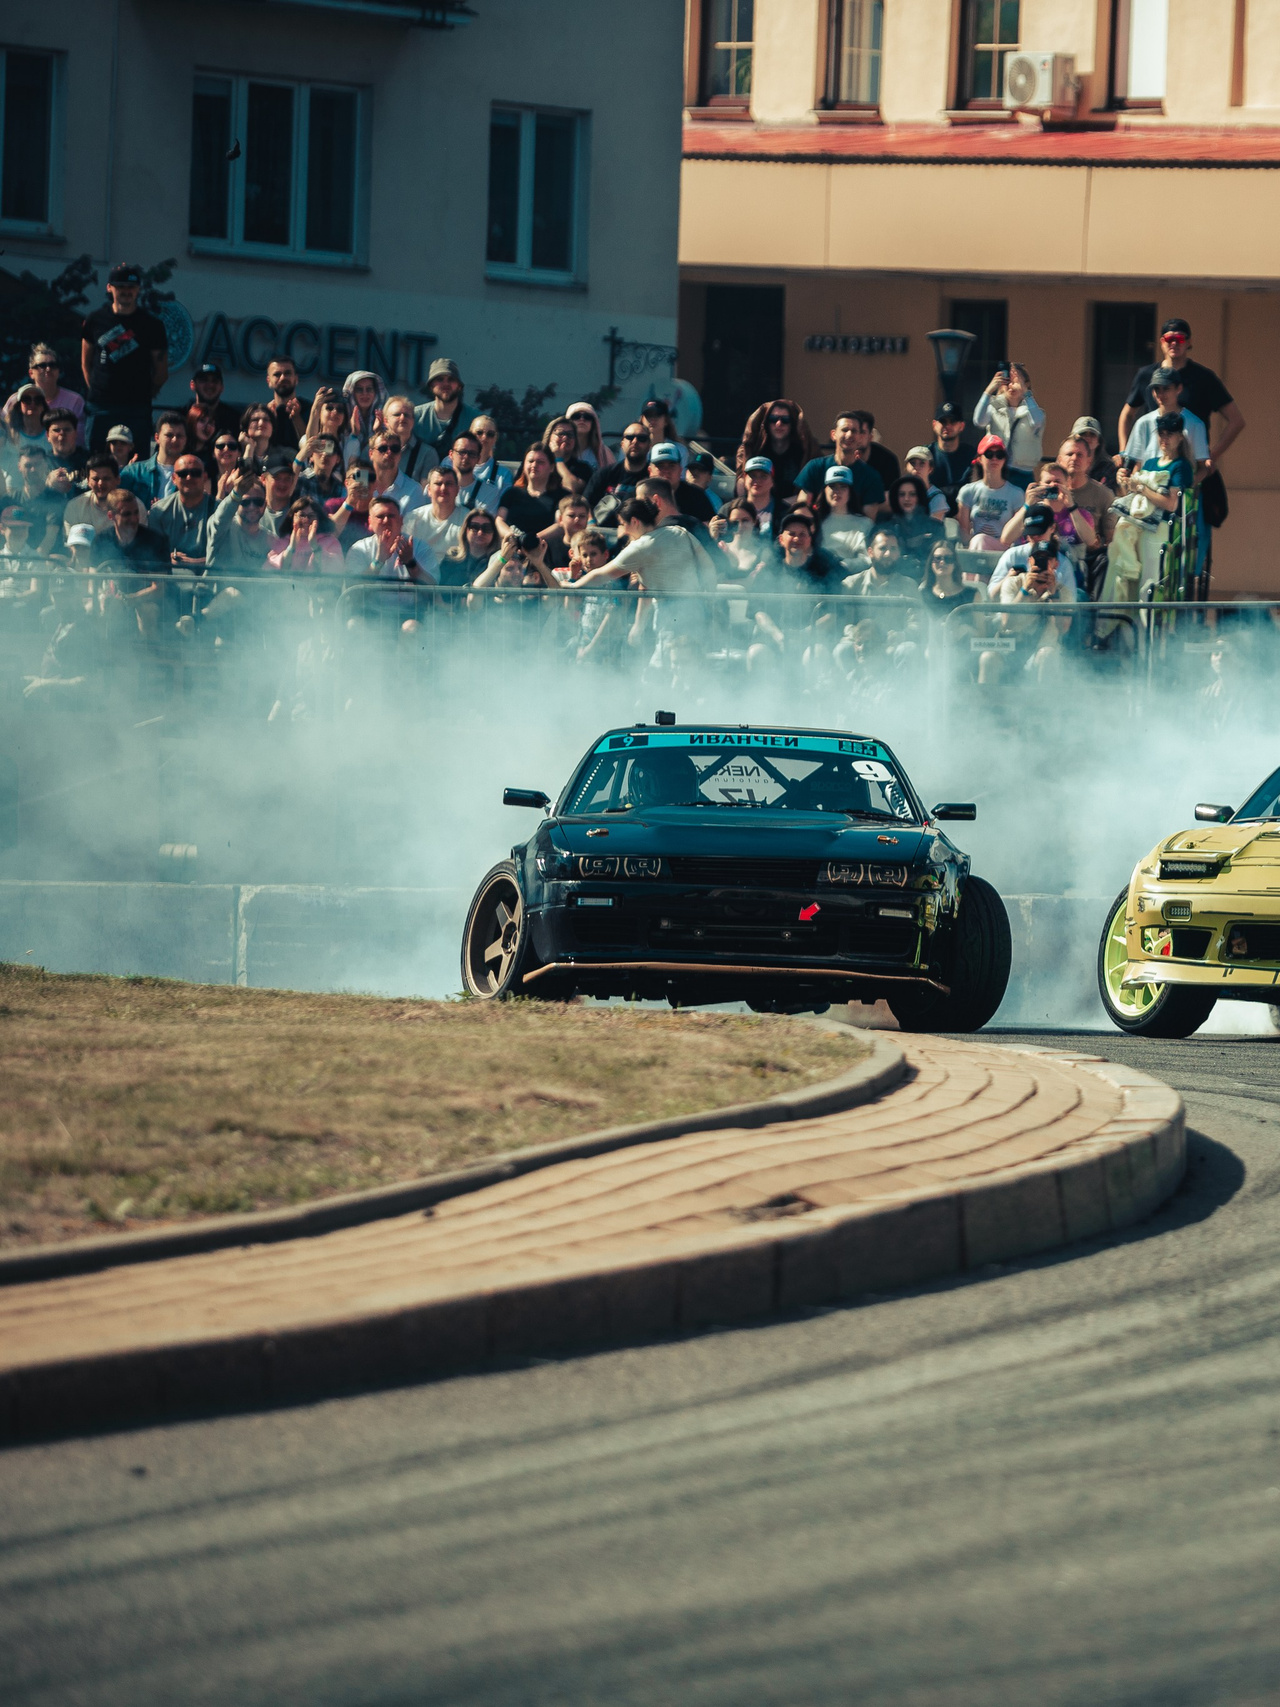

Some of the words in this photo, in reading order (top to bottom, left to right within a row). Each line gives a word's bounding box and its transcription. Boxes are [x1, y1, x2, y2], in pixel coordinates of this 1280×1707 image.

[199, 311, 439, 388] ACCENT
[623, 736, 634, 747] 9
[851, 760, 895, 782] 9
